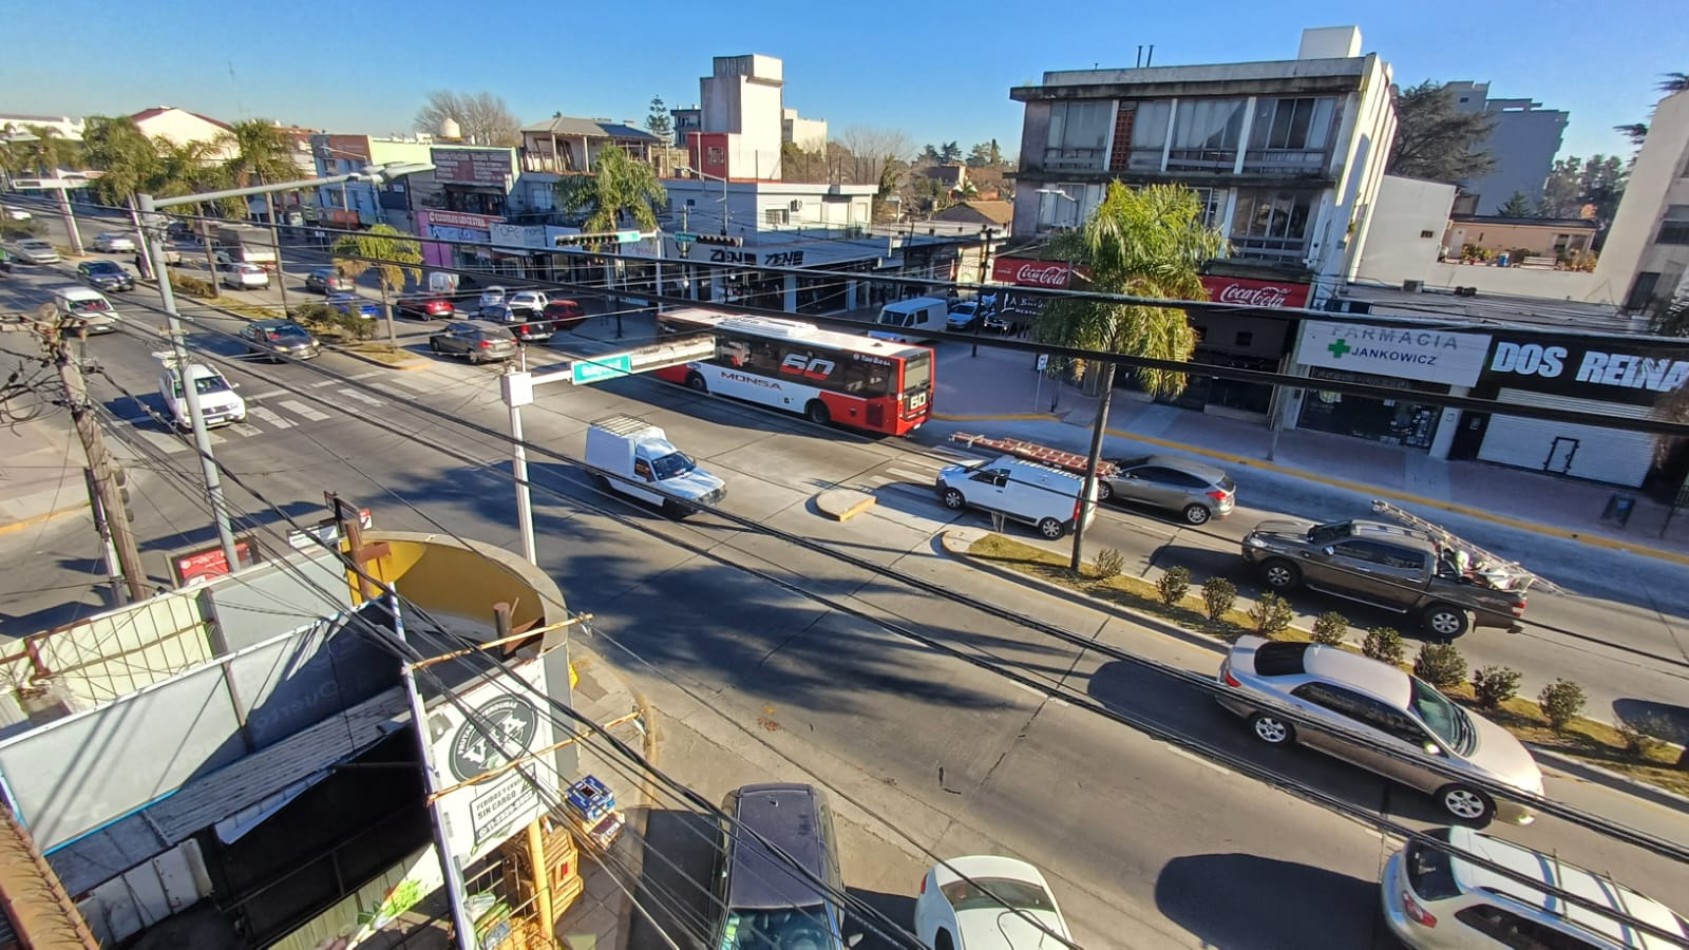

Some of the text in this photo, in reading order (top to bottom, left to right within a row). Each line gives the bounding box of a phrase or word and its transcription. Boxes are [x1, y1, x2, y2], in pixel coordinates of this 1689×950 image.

[1017, 264, 1068, 285] Coca-Cola
[1220, 283, 1290, 307] Coca-Cola
[1331, 326, 1458, 350] FARMACIA
[779, 353, 835, 380] 60
[1351, 347, 1438, 366] JANKOWICZ
[1490, 341, 1568, 378] DOS
[721, 371, 783, 391] MONSA
[910, 392, 926, 410] 60
[477, 790, 516, 820] SIN CARGO
